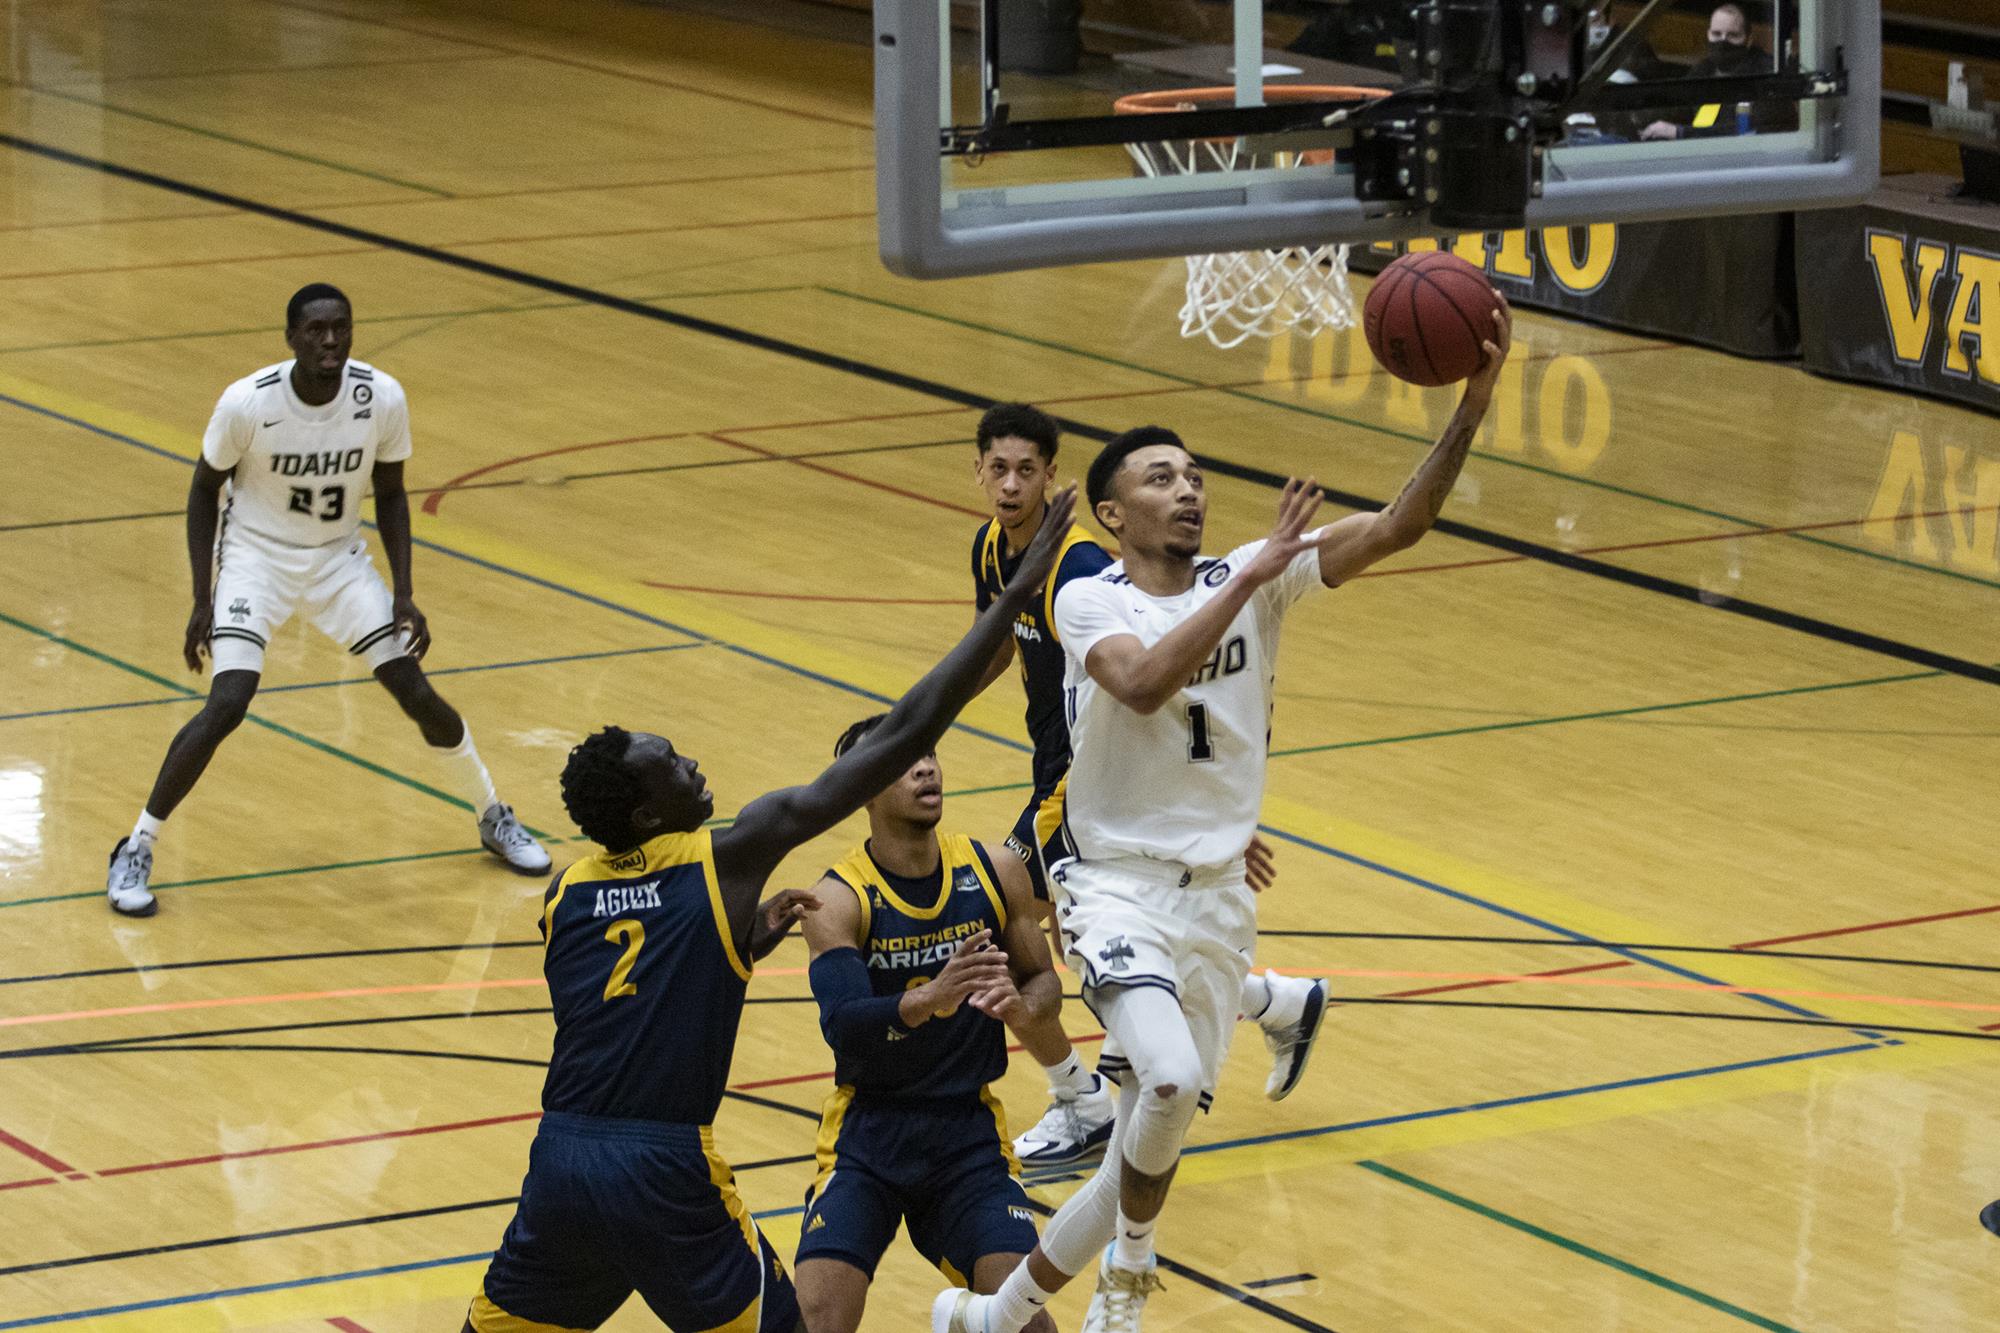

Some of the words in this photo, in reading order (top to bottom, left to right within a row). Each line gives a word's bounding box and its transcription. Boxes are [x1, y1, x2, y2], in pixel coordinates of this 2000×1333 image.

[270, 448, 363, 476] IDAHO
[288, 485, 346, 522] 23
[1185, 699, 1215, 764] 1
[871, 918, 985, 952] NORTHERN
[603, 919, 646, 1003] 2
